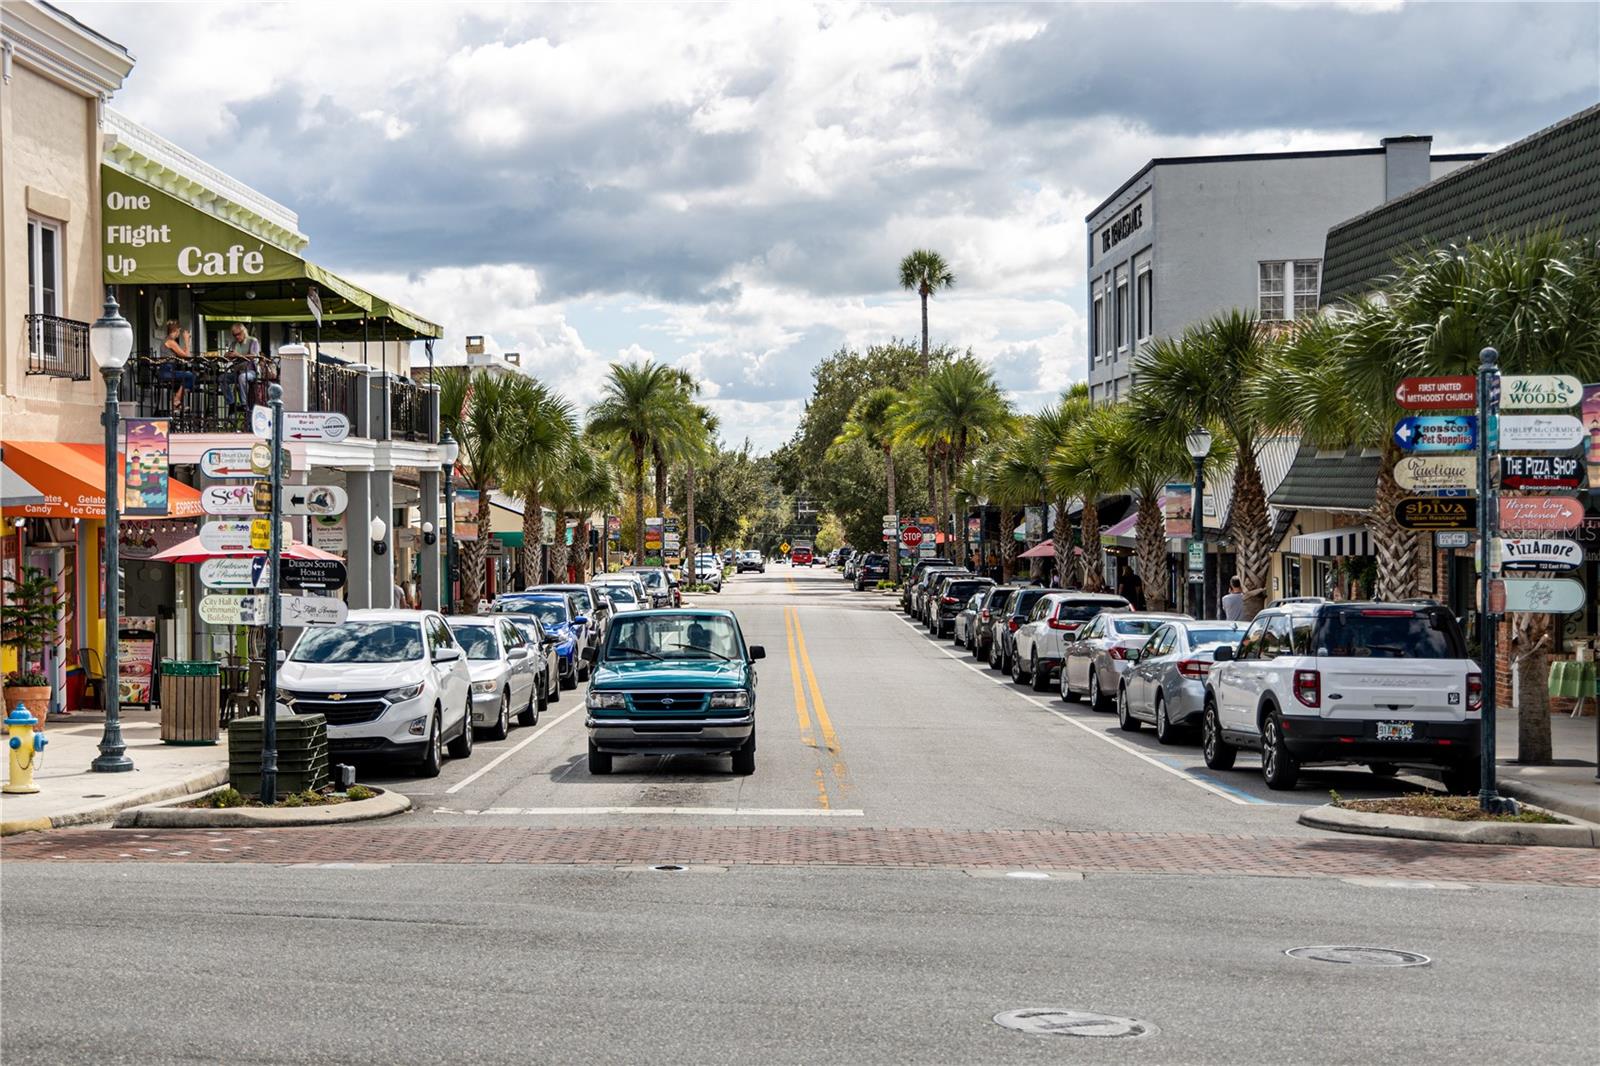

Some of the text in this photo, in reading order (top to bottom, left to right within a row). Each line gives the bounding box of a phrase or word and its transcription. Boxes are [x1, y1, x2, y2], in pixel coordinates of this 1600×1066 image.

[107, 191, 150, 210] One
[107, 224, 171, 248] Flight
[107, 254, 137, 276] Up
[177, 243, 264, 276] Café
[1418, 383, 1462, 392] FIRST UNITED
[1407, 393, 1473, 402] METHODIST CHURCH
[1509, 392, 1568, 404] WOODS
[1422, 434, 1473, 446] Pet Supplies
[1506, 457, 1577, 475] THE PIZZA SHOP
[78, 495, 106, 503] Gelato
[25, 504, 52, 515] Candy
[70, 506, 106, 515] Ice Crea
[1406, 501, 1466, 514] shiva
[903, 532, 922, 541] STOP
[289, 560, 313, 568] DESIGN
[204, 598, 217, 607] City
[219, 597, 232, 605] Hall
[201, 605, 239, 616] Community
[207, 614, 234, 624] Building
